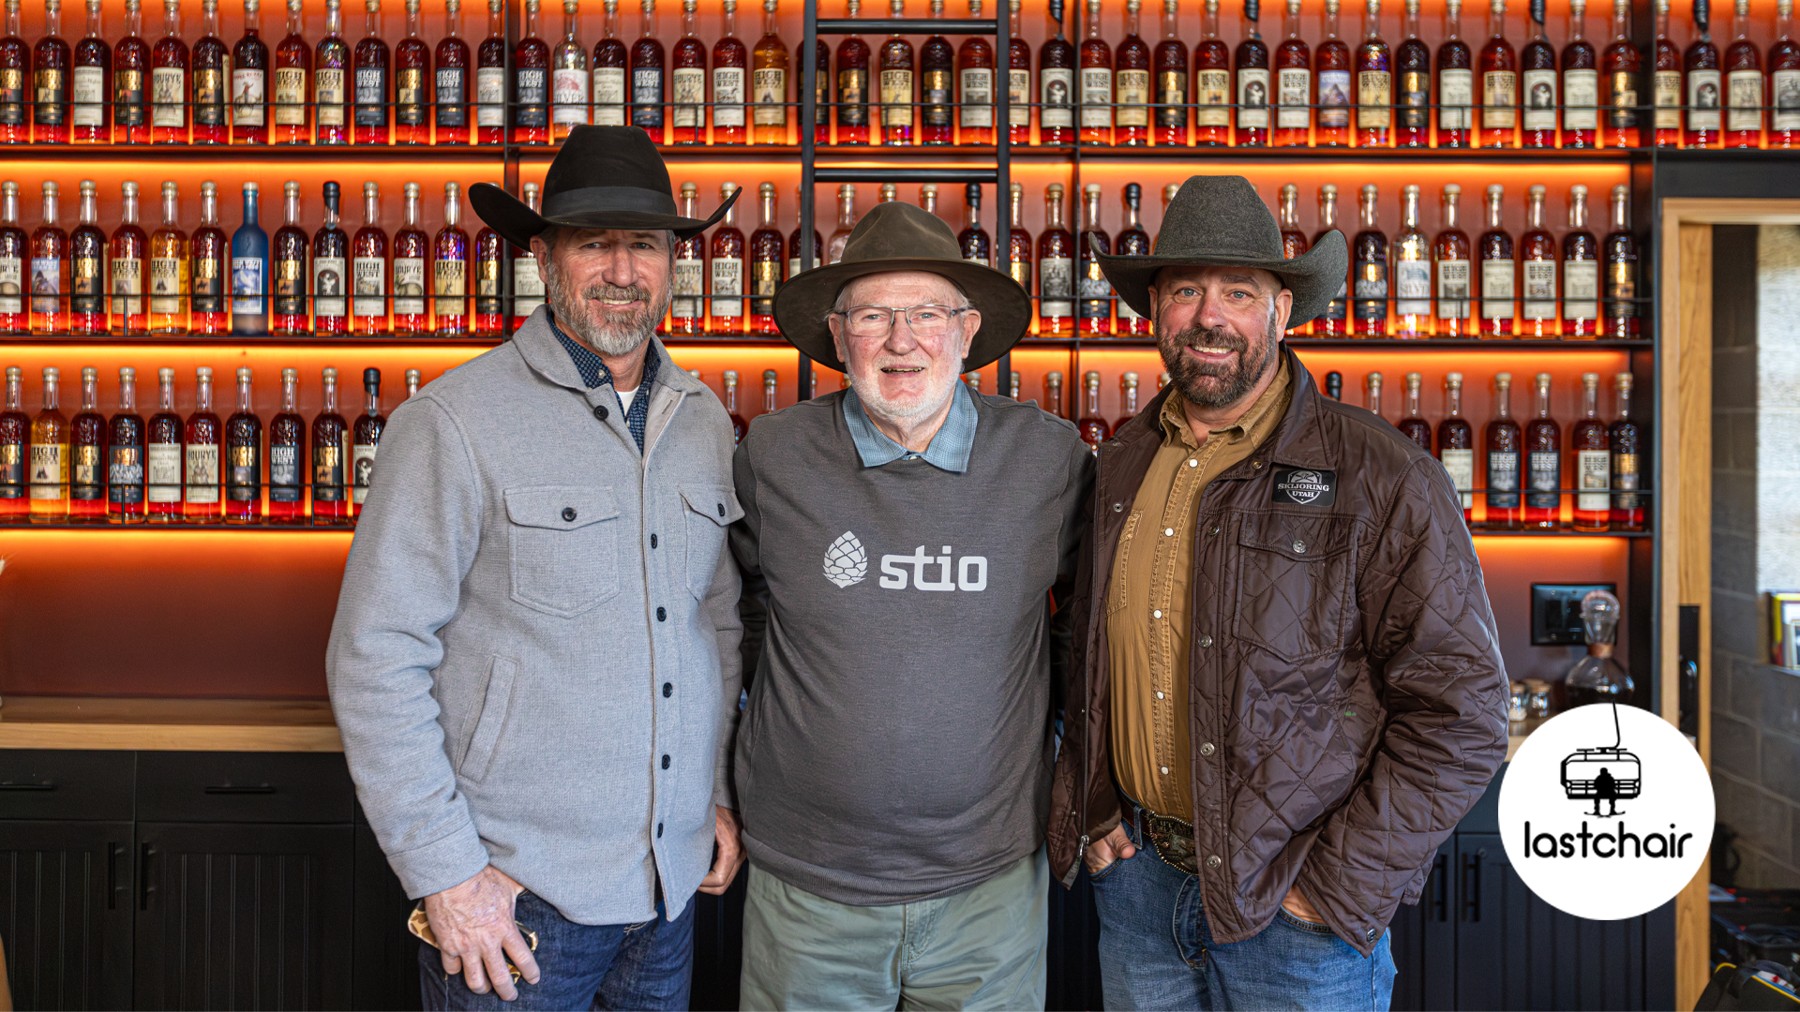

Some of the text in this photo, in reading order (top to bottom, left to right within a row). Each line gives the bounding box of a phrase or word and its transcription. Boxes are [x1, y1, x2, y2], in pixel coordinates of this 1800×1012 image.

[356, 70, 381, 79] HIGH
[436, 70, 461, 79] HIGH
[518, 70, 544, 79] HIGH
[634, 70, 660, 79] HIGH
[716, 71, 740, 79] HIGH
[754, 71, 782, 80] HIGH
[356, 262, 381, 270] HIGH
[714, 262, 739, 270] HIGH
[271, 447, 295, 456] HIGH
[1490, 453, 1517, 462] HIGH
[1531, 453, 1558, 462] HIGH
[1278, 483, 1330, 492] SKIJORING
[879, 545, 988, 592] stio
